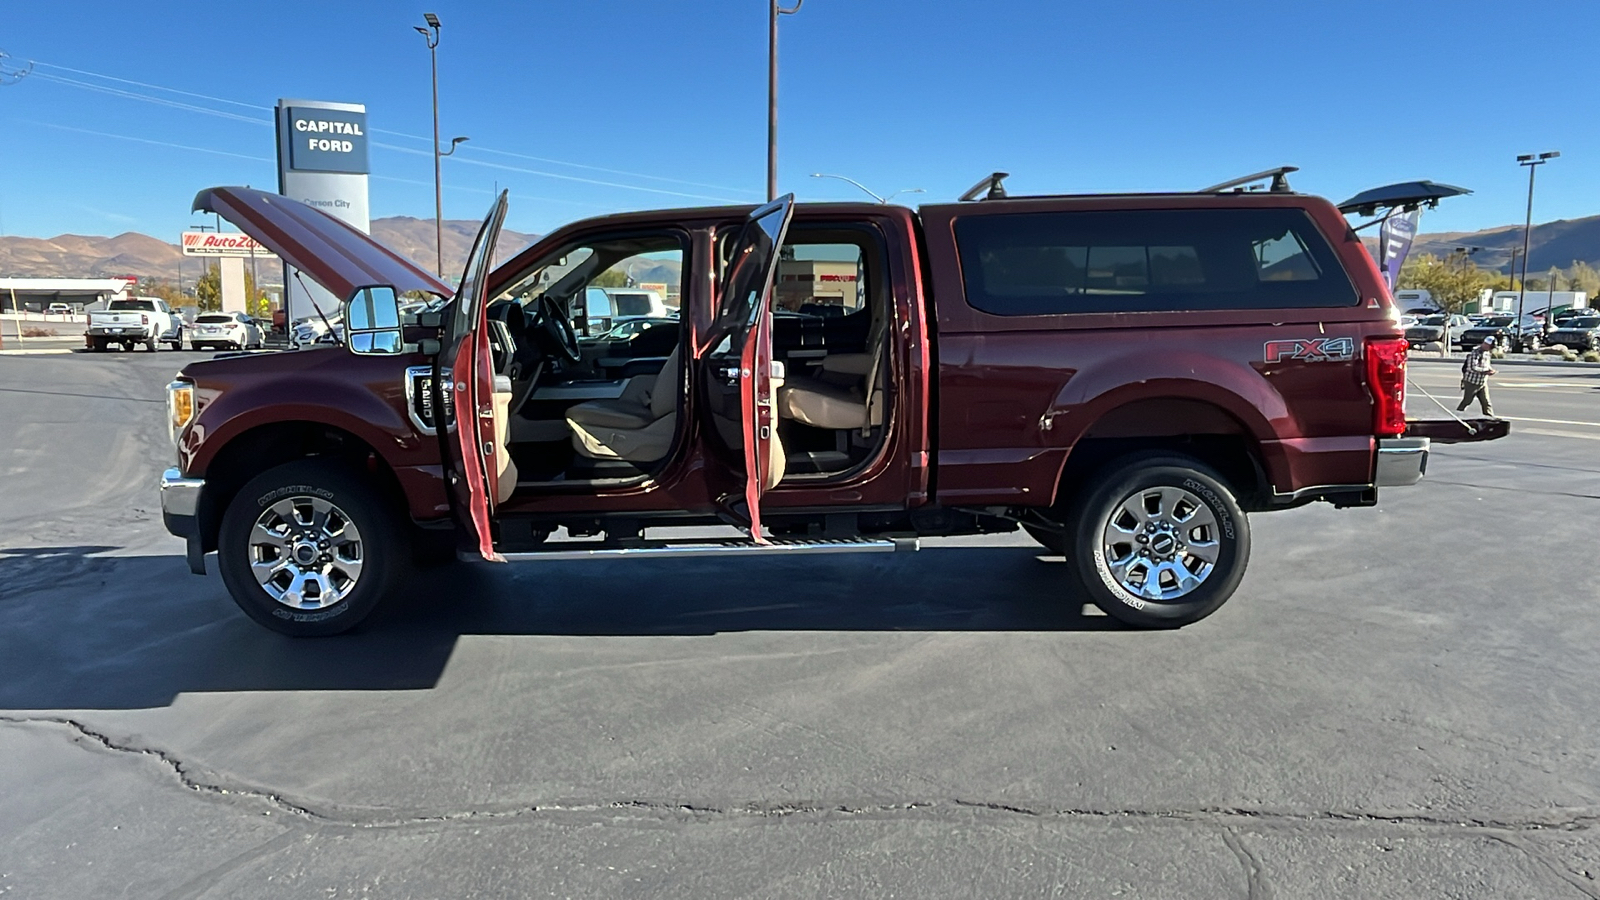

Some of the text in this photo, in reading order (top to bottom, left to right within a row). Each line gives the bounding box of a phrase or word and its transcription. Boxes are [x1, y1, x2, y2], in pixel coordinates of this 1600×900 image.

[295, 119, 364, 136] CAPITAL
[308, 138, 353, 153] FORD
[304, 198, 351, 209] Carson City
[1263, 337, 1354, 363] FX4
[258, 484, 334, 507] MICHELIN
[1183, 478, 1235, 540] MICHELIN
[1094, 549, 1146, 611] MICHELIN
